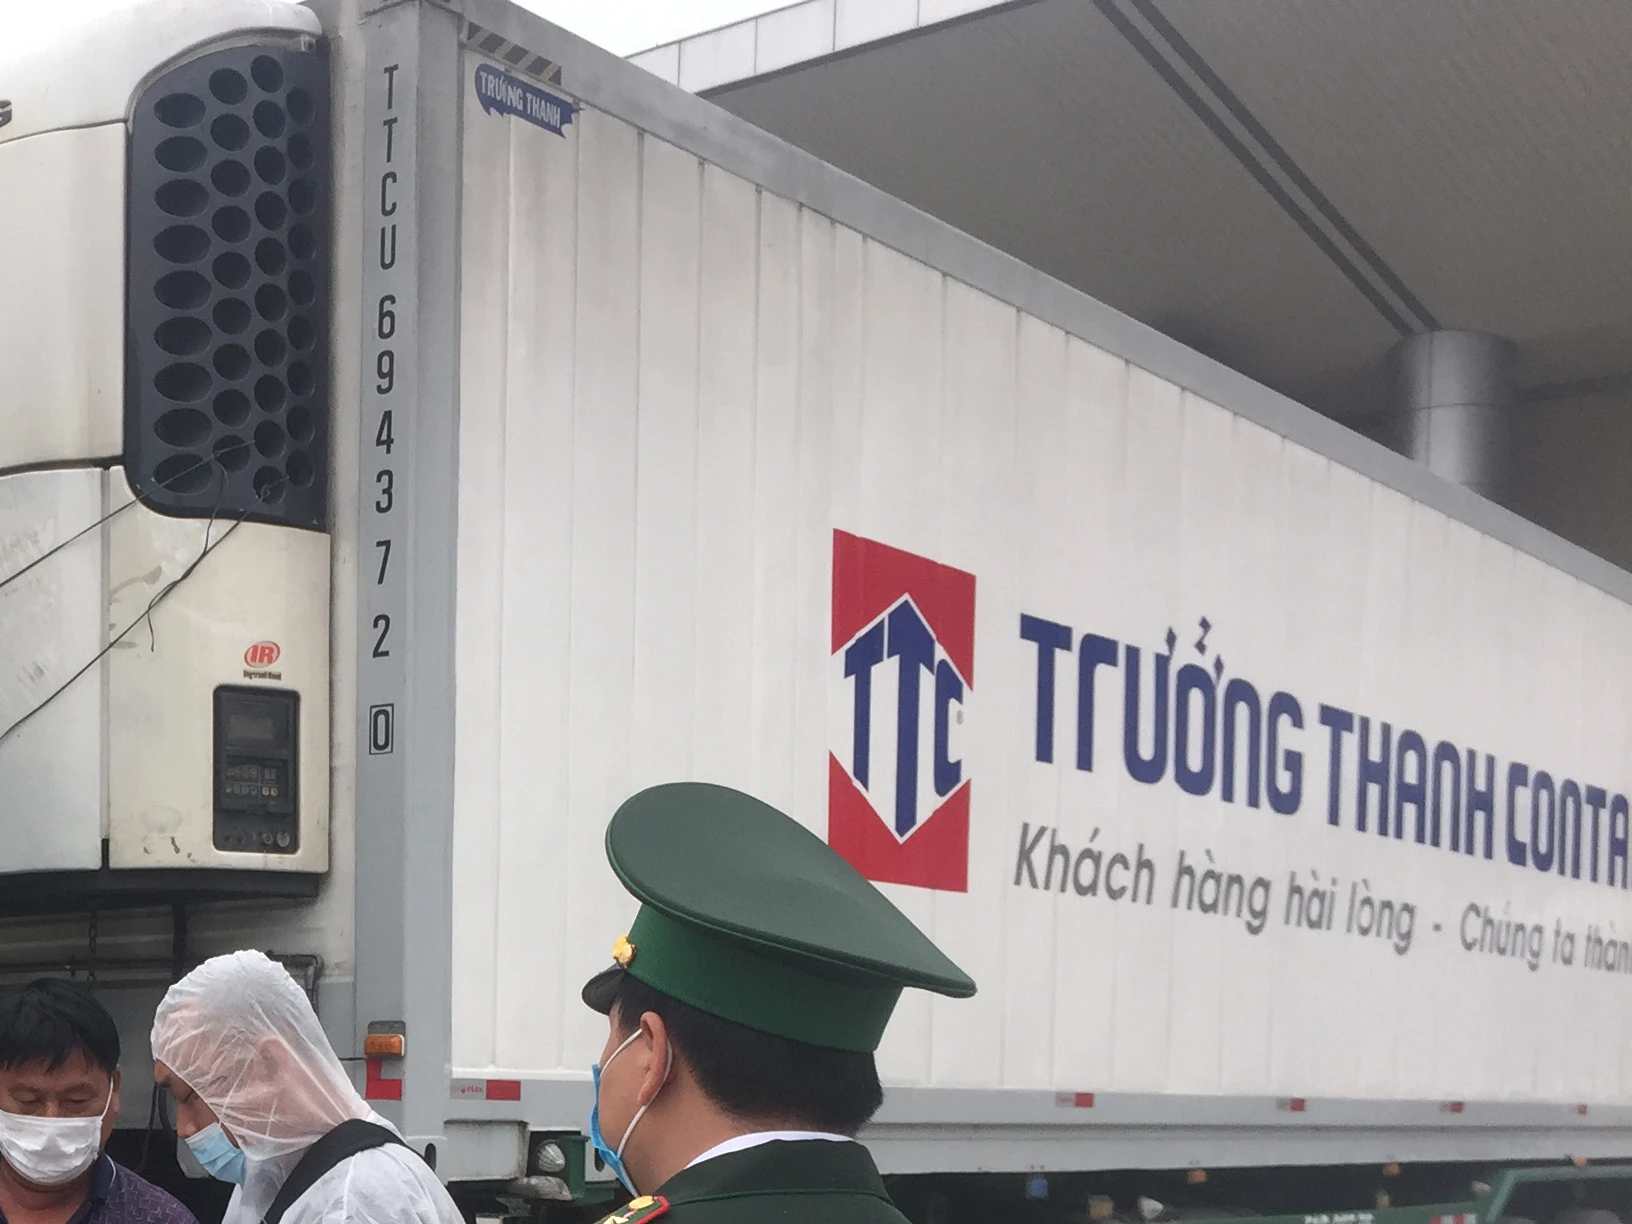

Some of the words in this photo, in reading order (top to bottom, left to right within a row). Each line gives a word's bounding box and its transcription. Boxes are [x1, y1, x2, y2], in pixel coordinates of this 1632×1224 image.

[844, 598, 964, 838] TTC
[1319, 703, 1496, 860] THANH
[1013, 822, 1156, 907] Khách
[1172, 847, 1270, 936] hàng
[1284, 869, 1338, 932] hài
[1345, 877, 1417, 956] lòng
[1460, 900, 1545, 972] Chúng
[1552, 917, 1575, 966] ta
[1584, 919, 1632, 974] thàn
